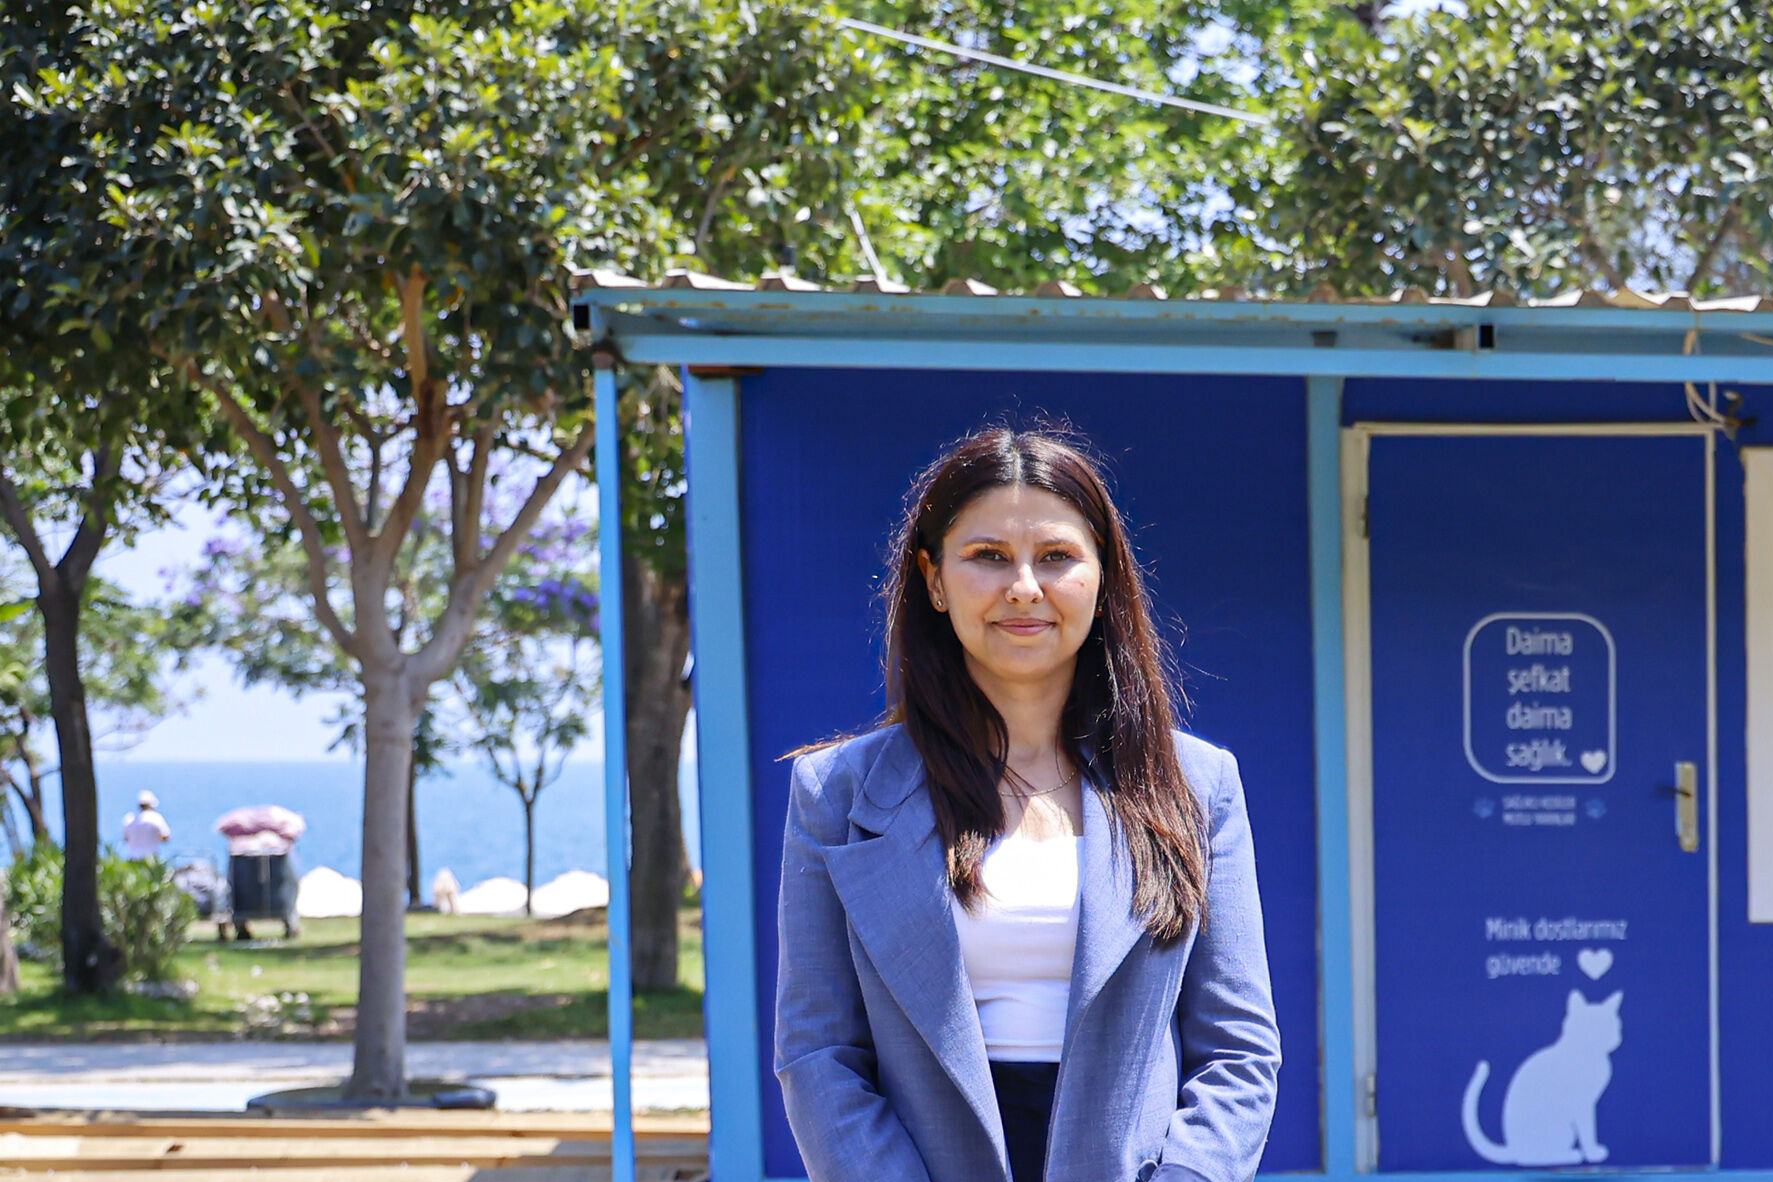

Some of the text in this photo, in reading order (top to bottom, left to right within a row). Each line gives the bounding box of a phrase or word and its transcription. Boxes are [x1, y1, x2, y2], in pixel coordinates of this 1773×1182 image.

[1506, 626, 1573, 655] Daima
[1507, 663, 1571, 696] şefkat
[1506, 700, 1573, 730] daima
